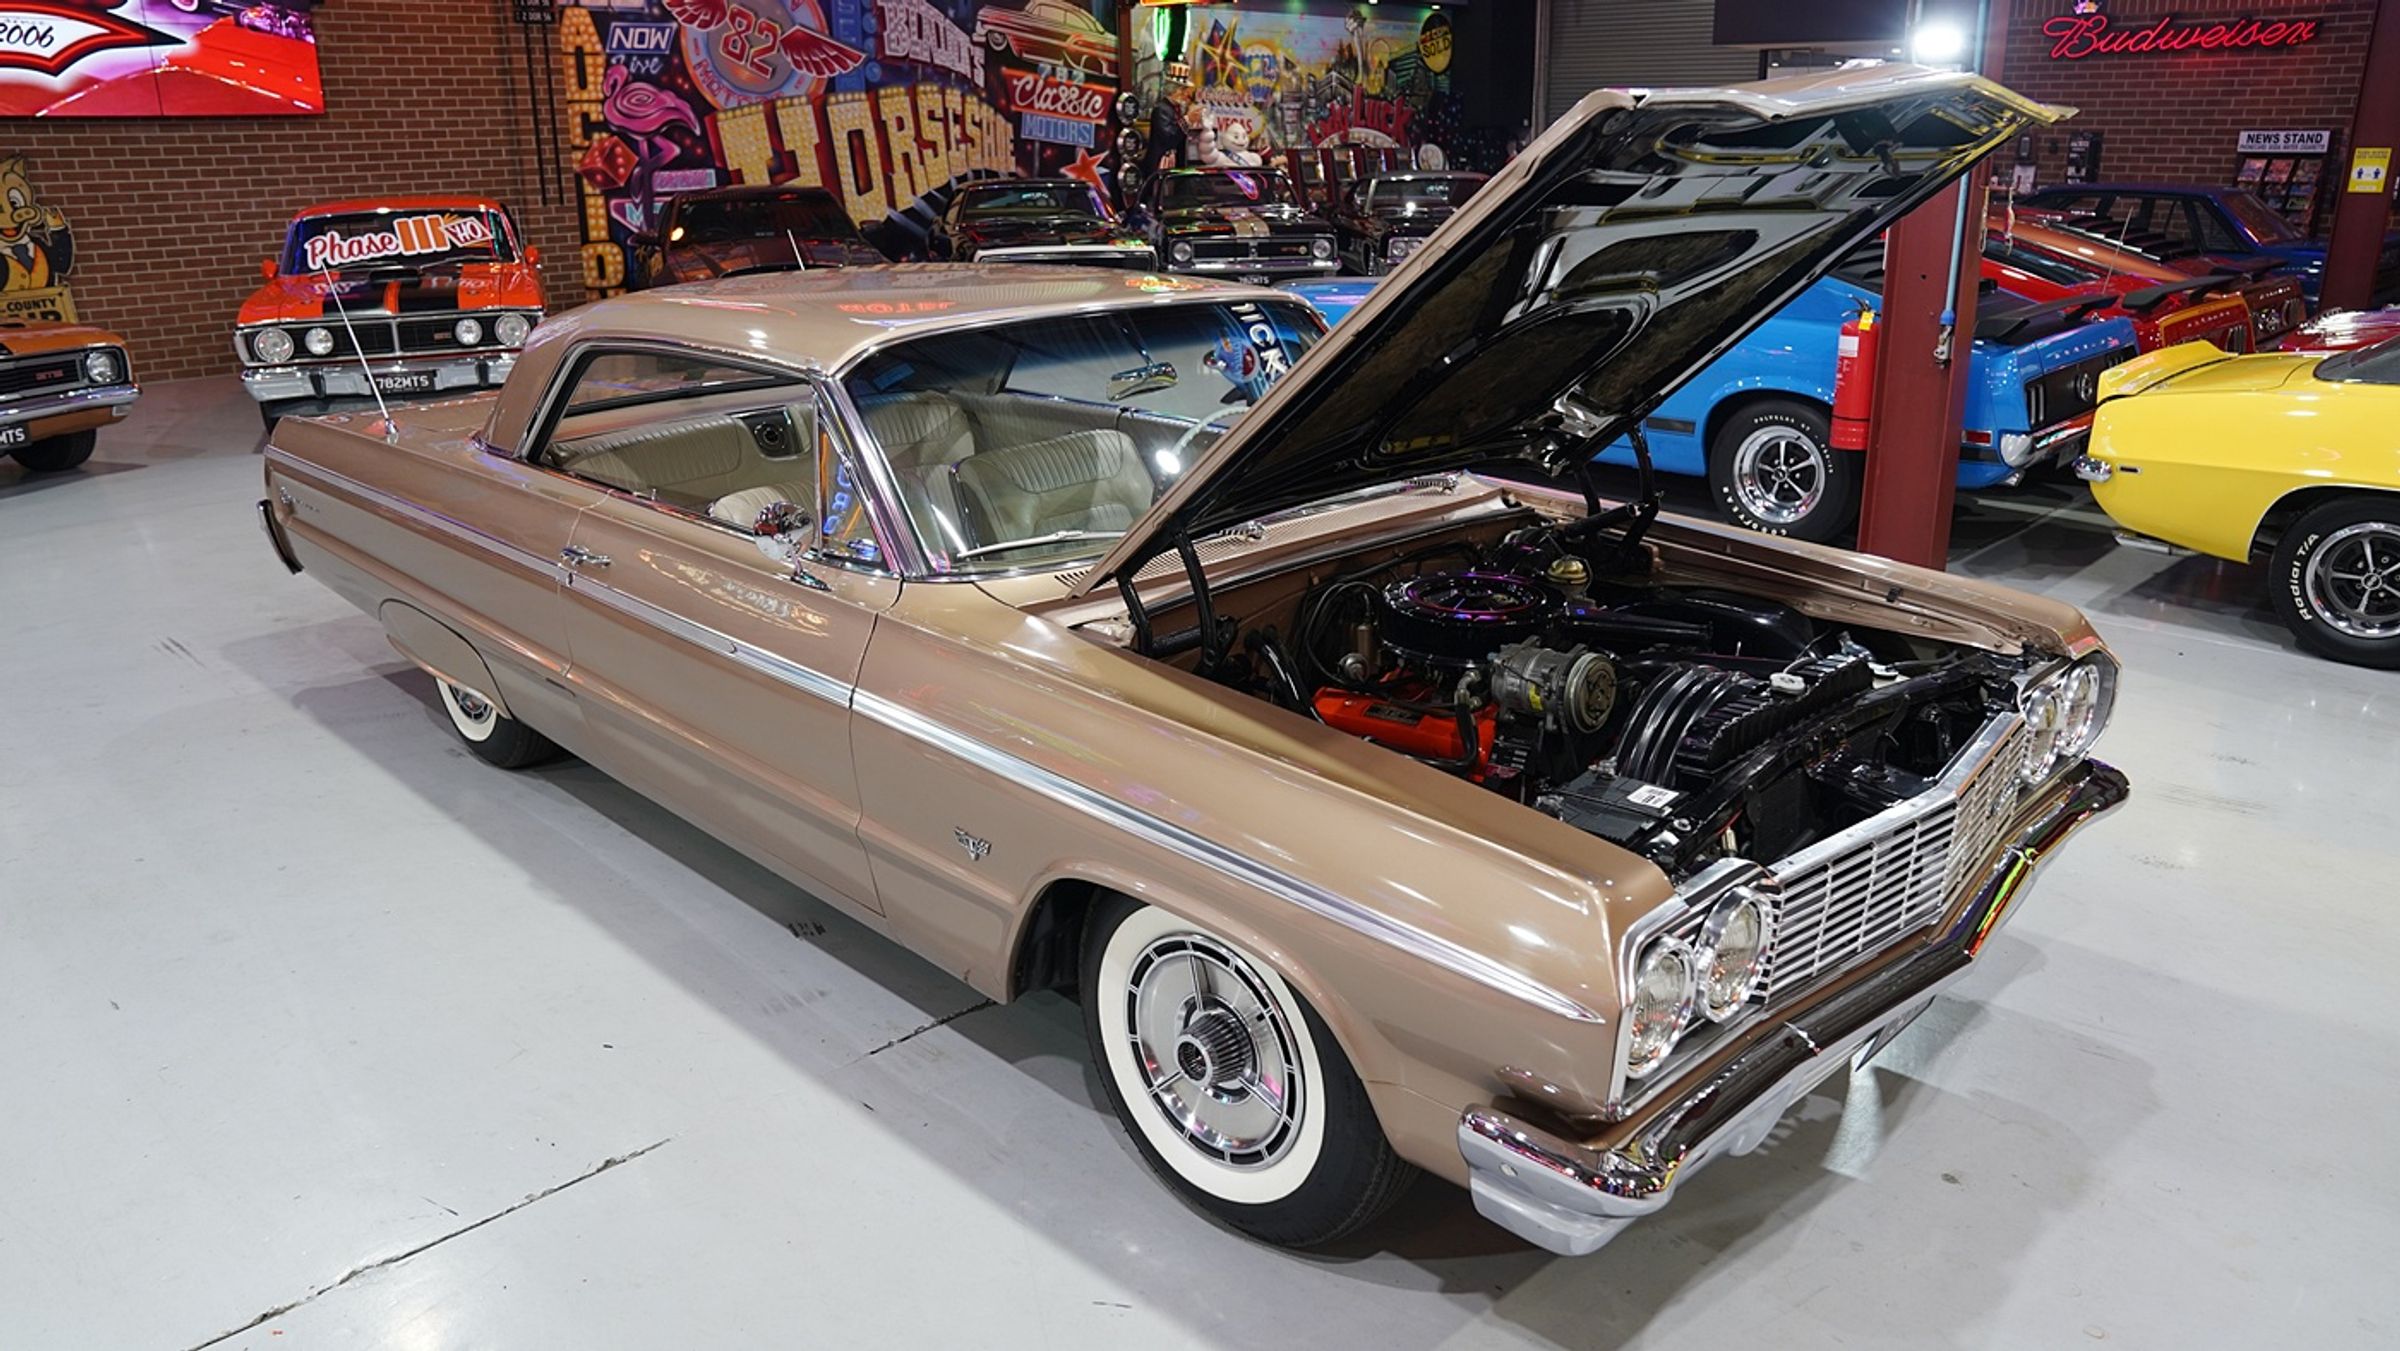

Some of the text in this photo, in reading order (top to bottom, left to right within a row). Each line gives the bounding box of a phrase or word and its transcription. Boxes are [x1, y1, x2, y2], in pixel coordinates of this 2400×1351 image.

[611, 27, 672, 50] NOW
[1423, 37, 1451, 57] SOLD
[2043, 15, 2318, 59] Budweiser
[1013, 74, 1104, 118] Classic
[1025, 114, 1091, 144] MOTORS
[1352, 83, 1415, 150] Luck
[2246, 133, 2323, 144] NEWS STAND
[304, 231, 398, 269] Phase
[6, 298, 57, 312] COUNTY
[375, 375, 429, 390] 782MTS
[2289, 533, 2320, 621] Radial T/A
